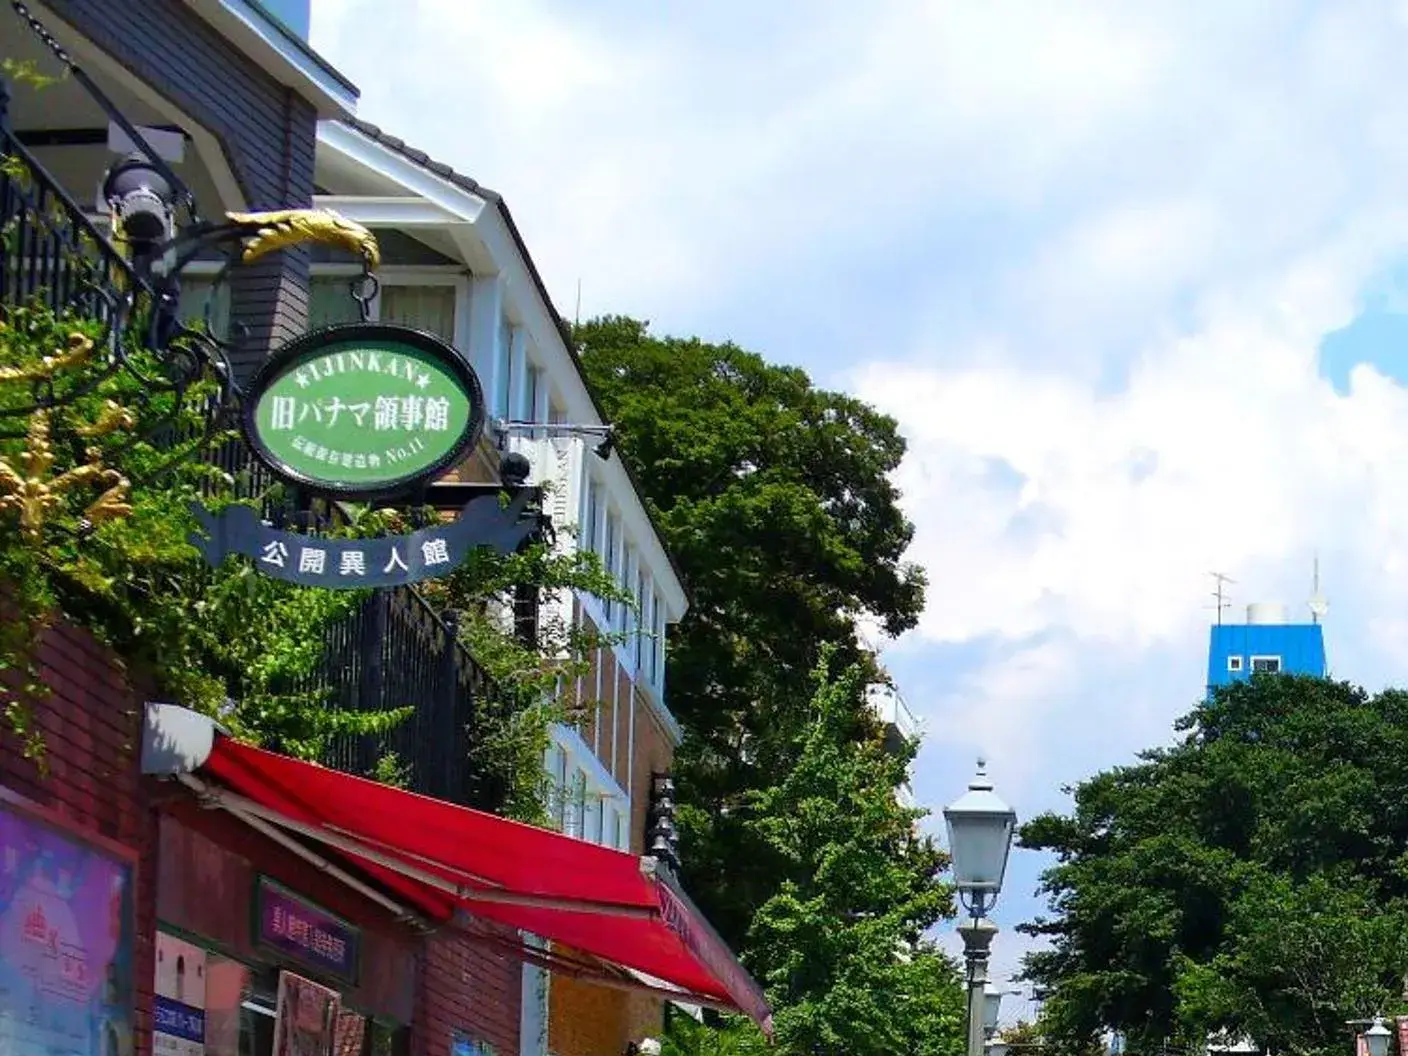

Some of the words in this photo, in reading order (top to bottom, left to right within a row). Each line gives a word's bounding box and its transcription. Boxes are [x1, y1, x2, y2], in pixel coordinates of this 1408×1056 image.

[308, 350, 418, 383] IJINKAN
[270, 394, 451, 432] 旧パナマ領事館
[384, 437, 427, 465] No.11
[260, 537, 451, 576] 公開異人館
